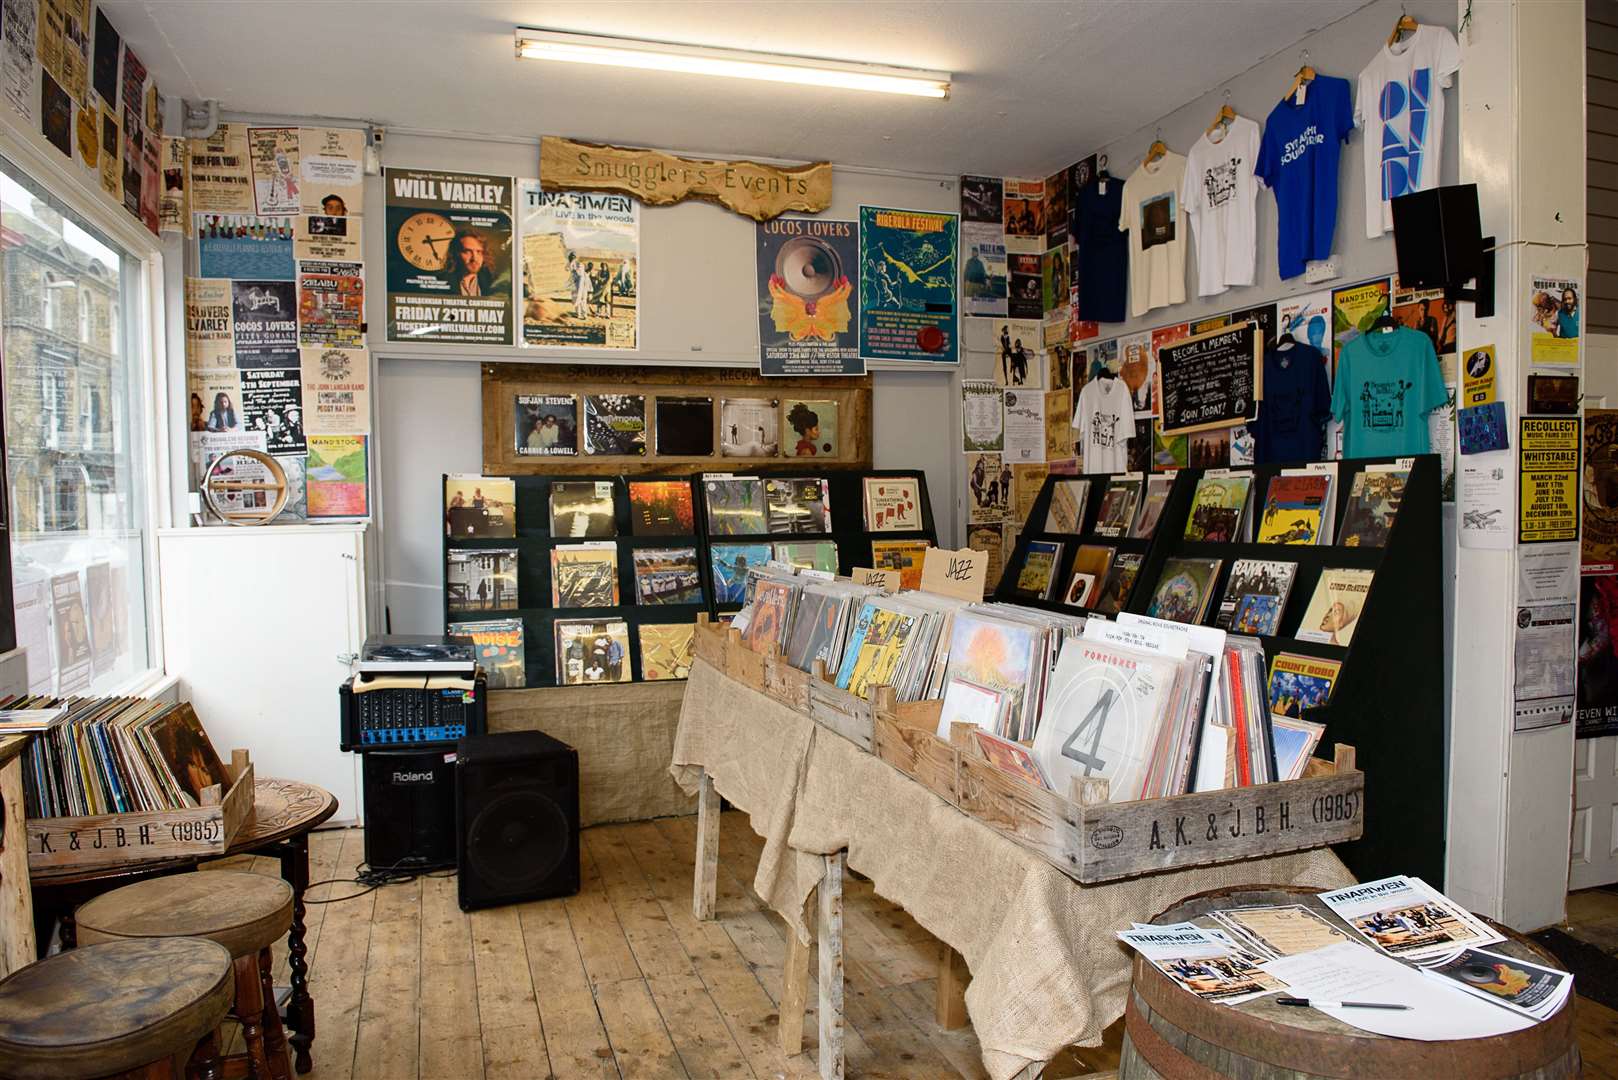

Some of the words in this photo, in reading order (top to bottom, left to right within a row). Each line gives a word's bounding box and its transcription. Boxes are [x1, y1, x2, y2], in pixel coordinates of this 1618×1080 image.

[576, 151, 708, 192] Smugglers
[725, 168, 809, 195] Events
[393, 178, 438, 200] WILL
[440, 182, 504, 204] VARLEY
[526, 191, 632, 213] TINARIWEN
[764, 220, 802, 235] COCOS
[807, 221, 850, 237] LOVERS
[395, 306, 441, 321] FRIDAY
[443, 308, 475, 322] 29TH
[478, 309, 505, 323] MAY
[235, 321, 263, 332] COCOS
[265, 321, 296, 332] LOVERS
[1172, 343, 1200, 362] BECOME
[1201, 341, 1207, 352] A
[1208, 330, 1243, 350] MEMBER!
[246, 371, 286, 379] SATURDAY
[258, 380, 300, 388] SEPTEMBER
[545, 396, 574, 406] STEVENS
[1179, 408, 1199, 423] JOIN
[1199, 401, 1227, 417] TODAY!
[1524, 421, 1577, 432] RECOLLECT
[549, 447, 574, 455] LOWELL
[1524, 452, 1577, 462] WHITSTABLE
[944, 557, 974, 582] JAZZ
[1231, 560, 1292, 577] RAMONES
[864, 572, 886, 588] JAZZ
[472, 631, 521, 648] NOISE
[1083, 647, 1138, 671] FOREIGNER
[1275, 660, 1306, 674] COUNT
[1576, 708, 1602, 720] TEVEN
[1060, 687, 1115, 778] 4
[392, 770, 434, 783] Roland
[1150, 820, 1166, 850] A.
[1175, 817, 1192, 846] K.
[1206, 813, 1219, 841] &
[1230, 808, 1246, 837] J.
[1255, 806, 1271, 833] B.
[1279, 802, 1295, 831] H.
[1312, 791, 1360, 824] (1985)
[40, 834, 57, 853] K.
[69, 832, 81, 851] &
[93, 830, 107, 850] J.
[116, 828, 131, 848] B.
[140, 826, 155, 846] H.
[171, 820, 219, 842] (1985)
[1326, 880, 1407, 903] TINARIWEN
[1127, 932, 1205, 943] TINARIWEN
